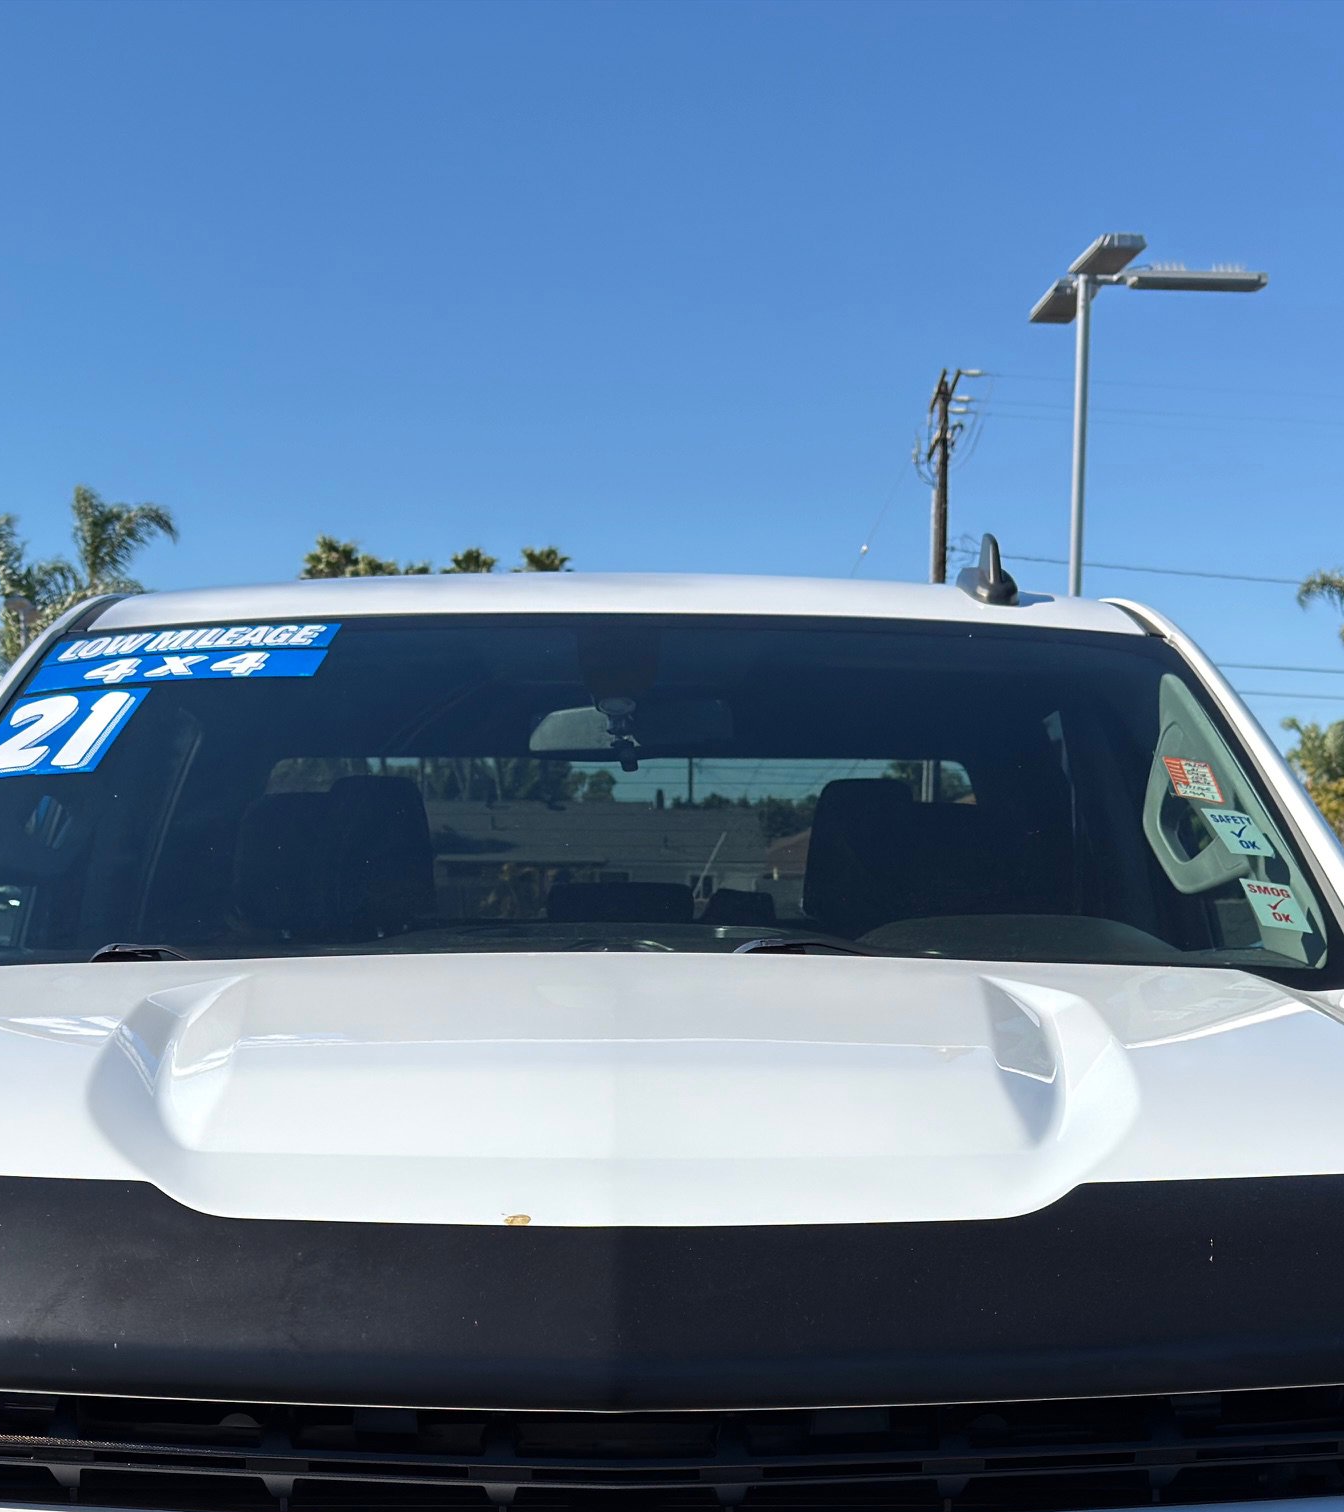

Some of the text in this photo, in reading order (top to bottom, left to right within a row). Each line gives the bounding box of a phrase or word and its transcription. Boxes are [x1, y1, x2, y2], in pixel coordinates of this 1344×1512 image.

[57, 625, 327, 662] LOW MILEAGE
[1210, 814, 1253, 826] SAFETY
[1239, 839, 1261, 850] OK
[1247, 883, 1291, 898] SMOG
[1272, 912, 1295, 924] OK
